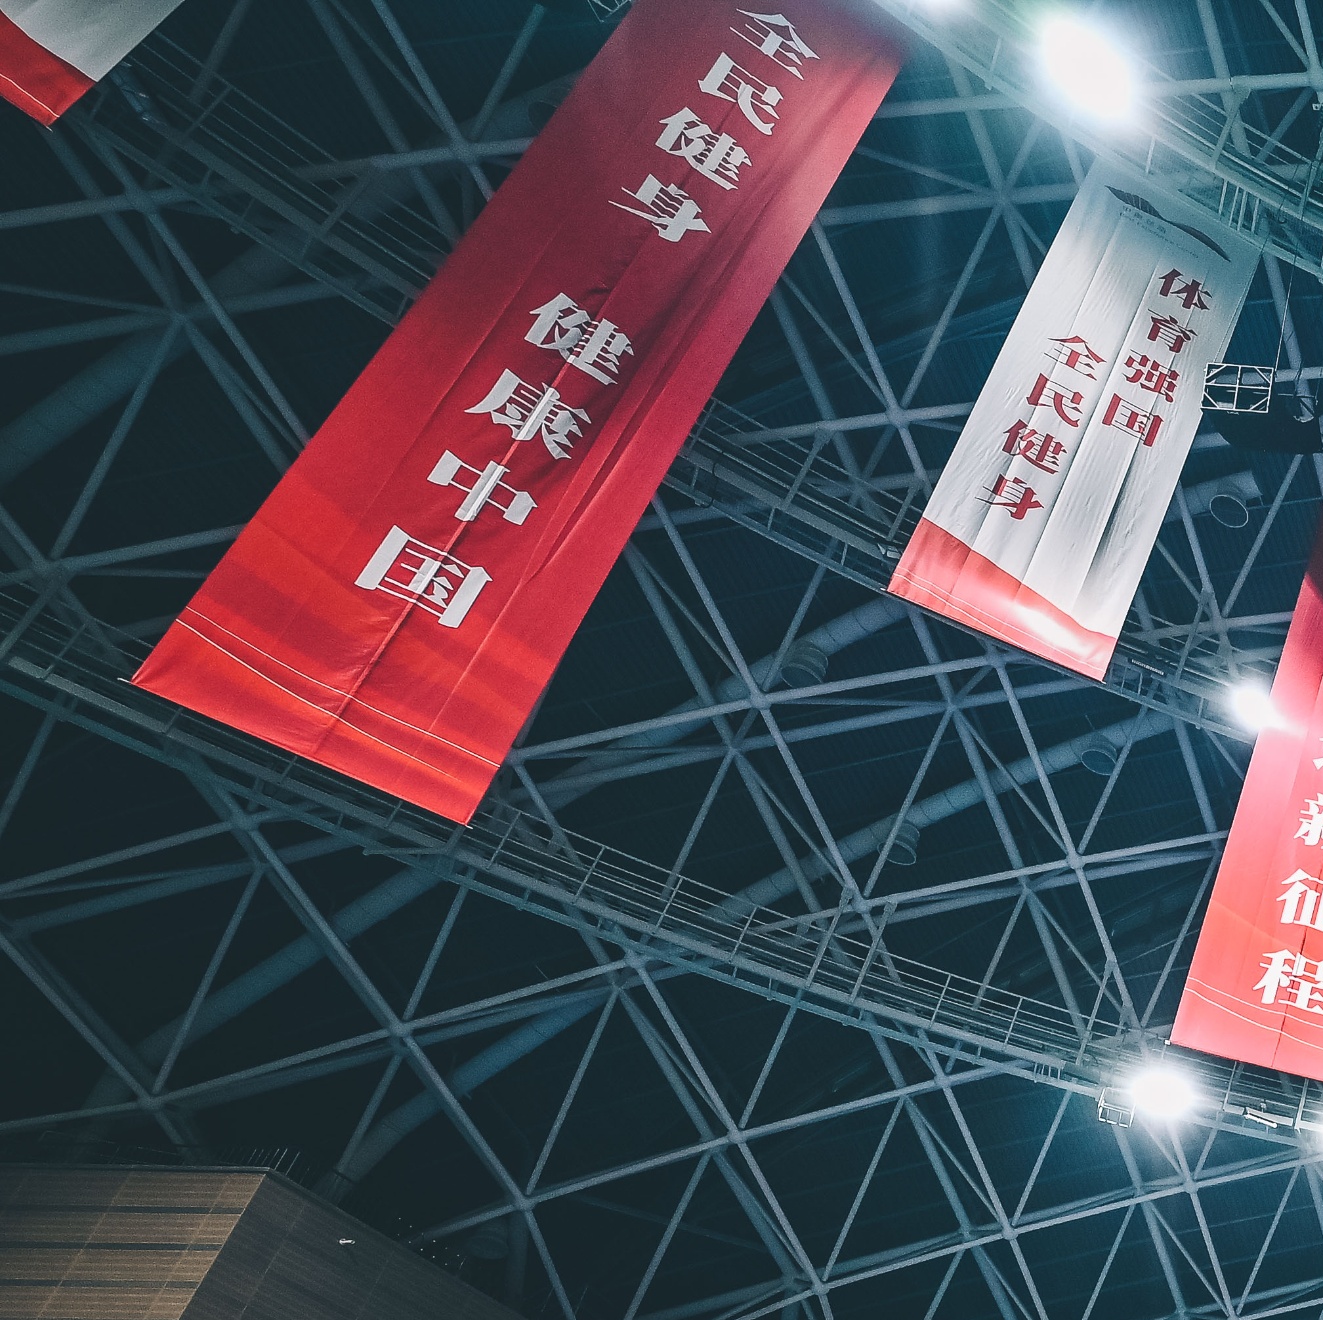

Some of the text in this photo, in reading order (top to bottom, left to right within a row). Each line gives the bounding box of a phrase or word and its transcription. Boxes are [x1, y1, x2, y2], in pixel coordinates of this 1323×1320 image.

[354, 7, 821, 630] 全民健身 健康中国
[1102, 267, 1213, 449] 体育强国
[974, 334, 1107, 521] 全民健身
